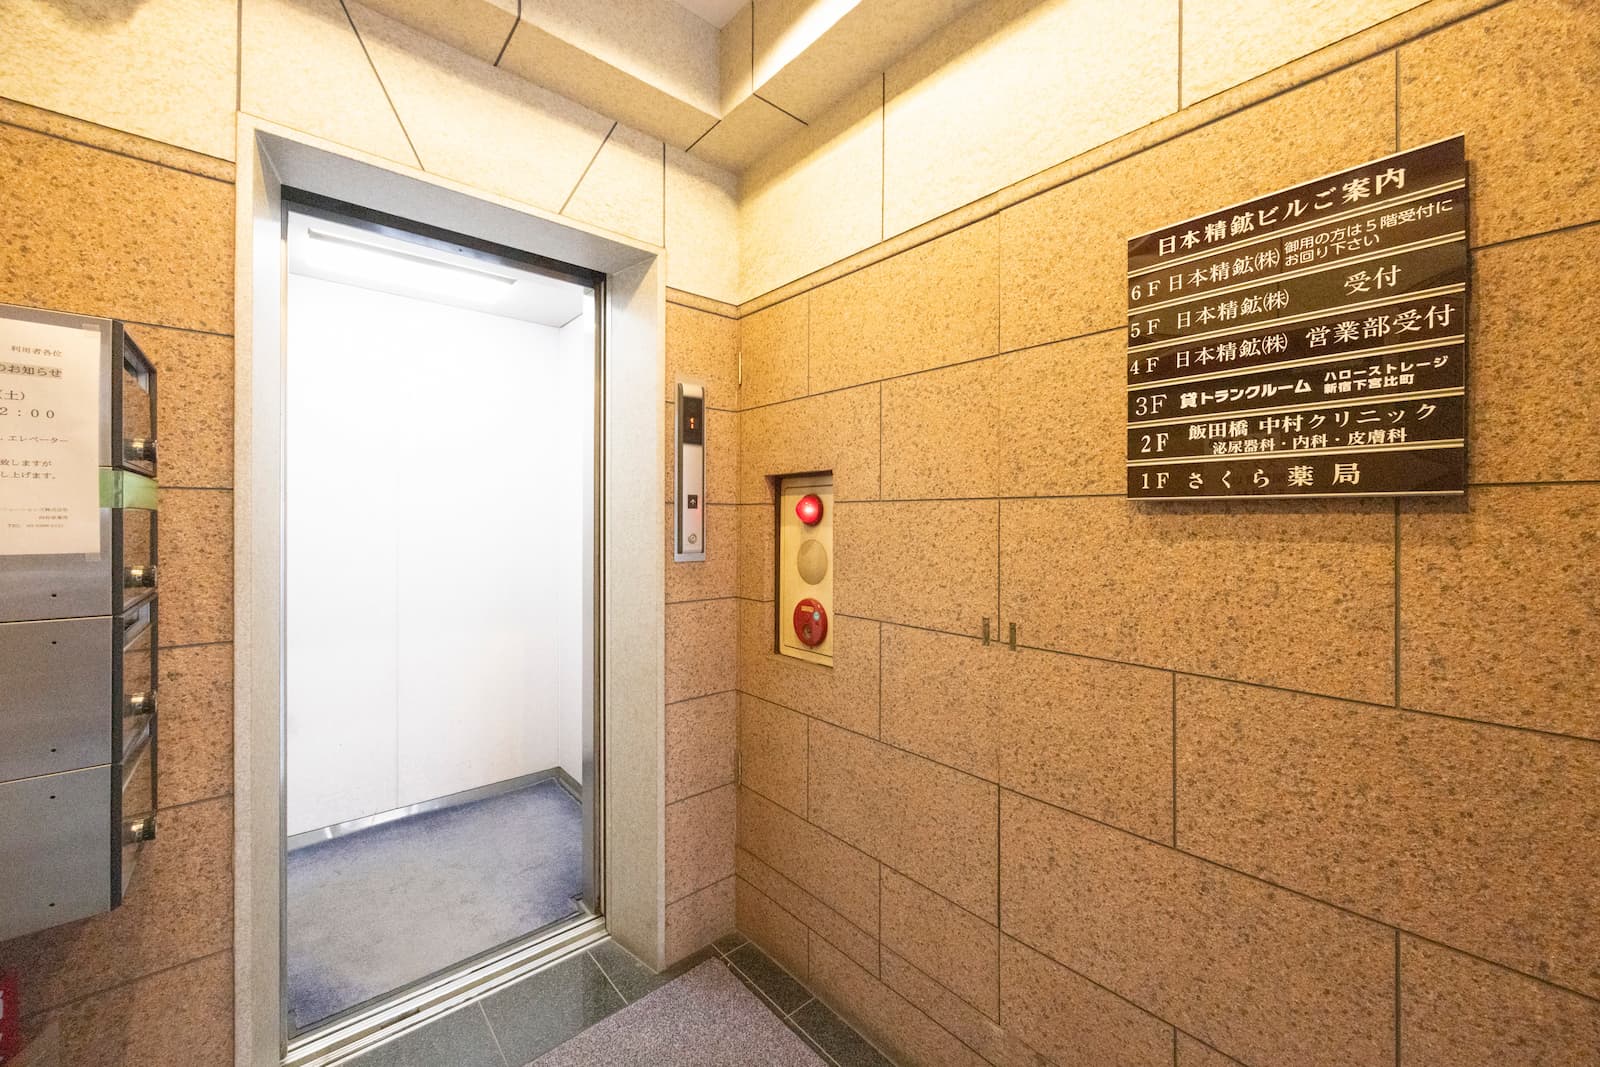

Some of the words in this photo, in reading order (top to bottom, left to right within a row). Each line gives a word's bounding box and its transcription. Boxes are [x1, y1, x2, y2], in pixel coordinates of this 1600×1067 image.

[1285, 234, 1380, 267] お回り下さい
[1344, 265, 1402, 296] 受付
[1305, 304, 1455, 348] 営業部受付
[1324, 355, 1449, 382] ハローストレージ
[1324, 374, 1415, 394] 新宿下宮比町
[1135, 394, 1167, 416] 3F
[1180, 379, 1312, 409] 貸トランクルーム
[1141, 433, 1169, 453] 2F
[1188, 420, 1249, 441] 飯田橋
[1258, 403, 1437, 435] 中村クリニック
[1141, 472, 1169, 489] 1F
